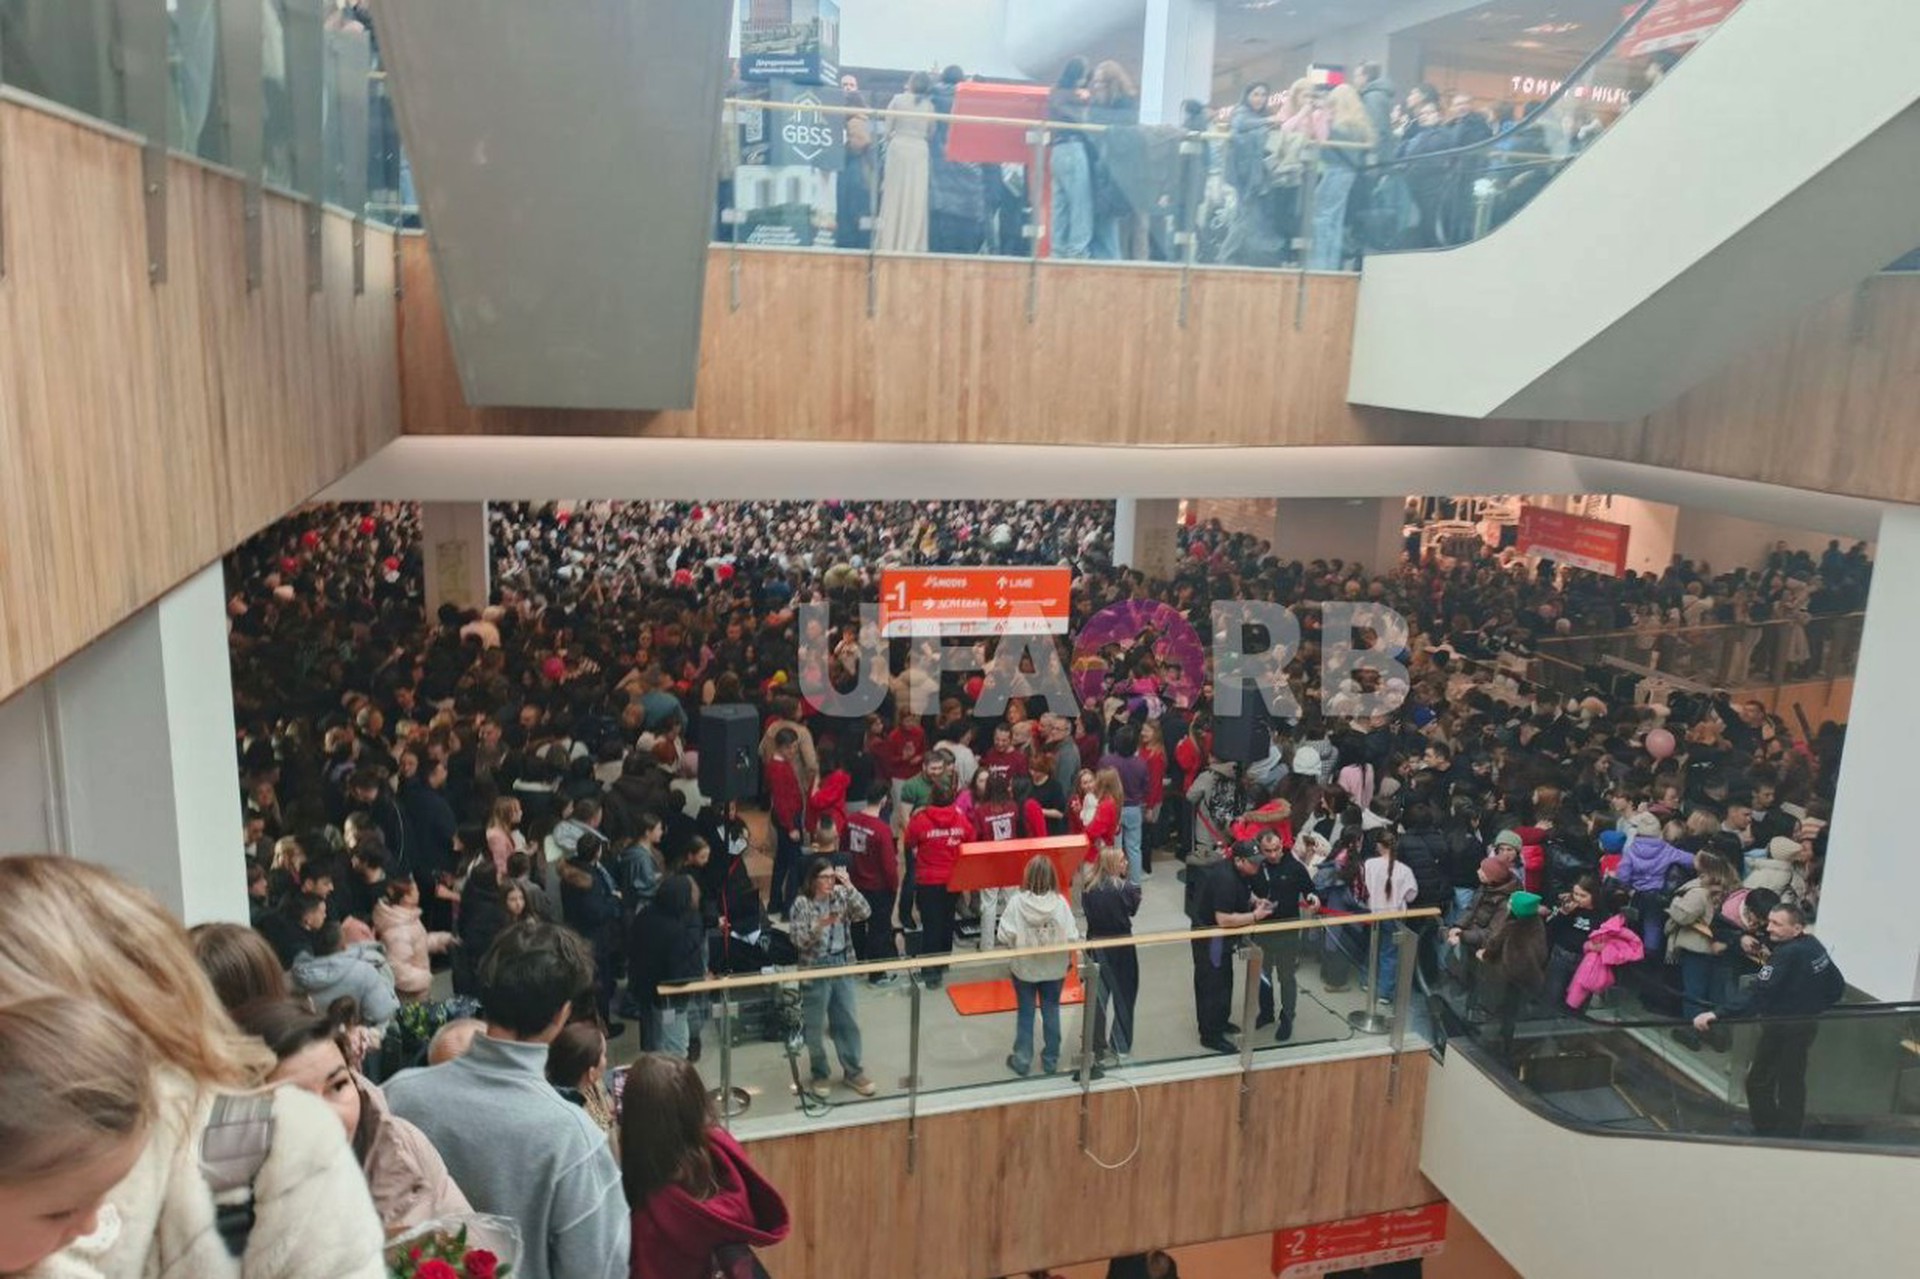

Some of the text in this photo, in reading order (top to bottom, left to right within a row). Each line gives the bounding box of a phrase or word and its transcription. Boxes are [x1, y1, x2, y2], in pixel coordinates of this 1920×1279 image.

[1512, 76, 1569, 97] TOMM
[782, 124, 832, 147] GBSS
[884, 580, 906, 610] -1
[1285, 1229, 1305, 1256] -2
